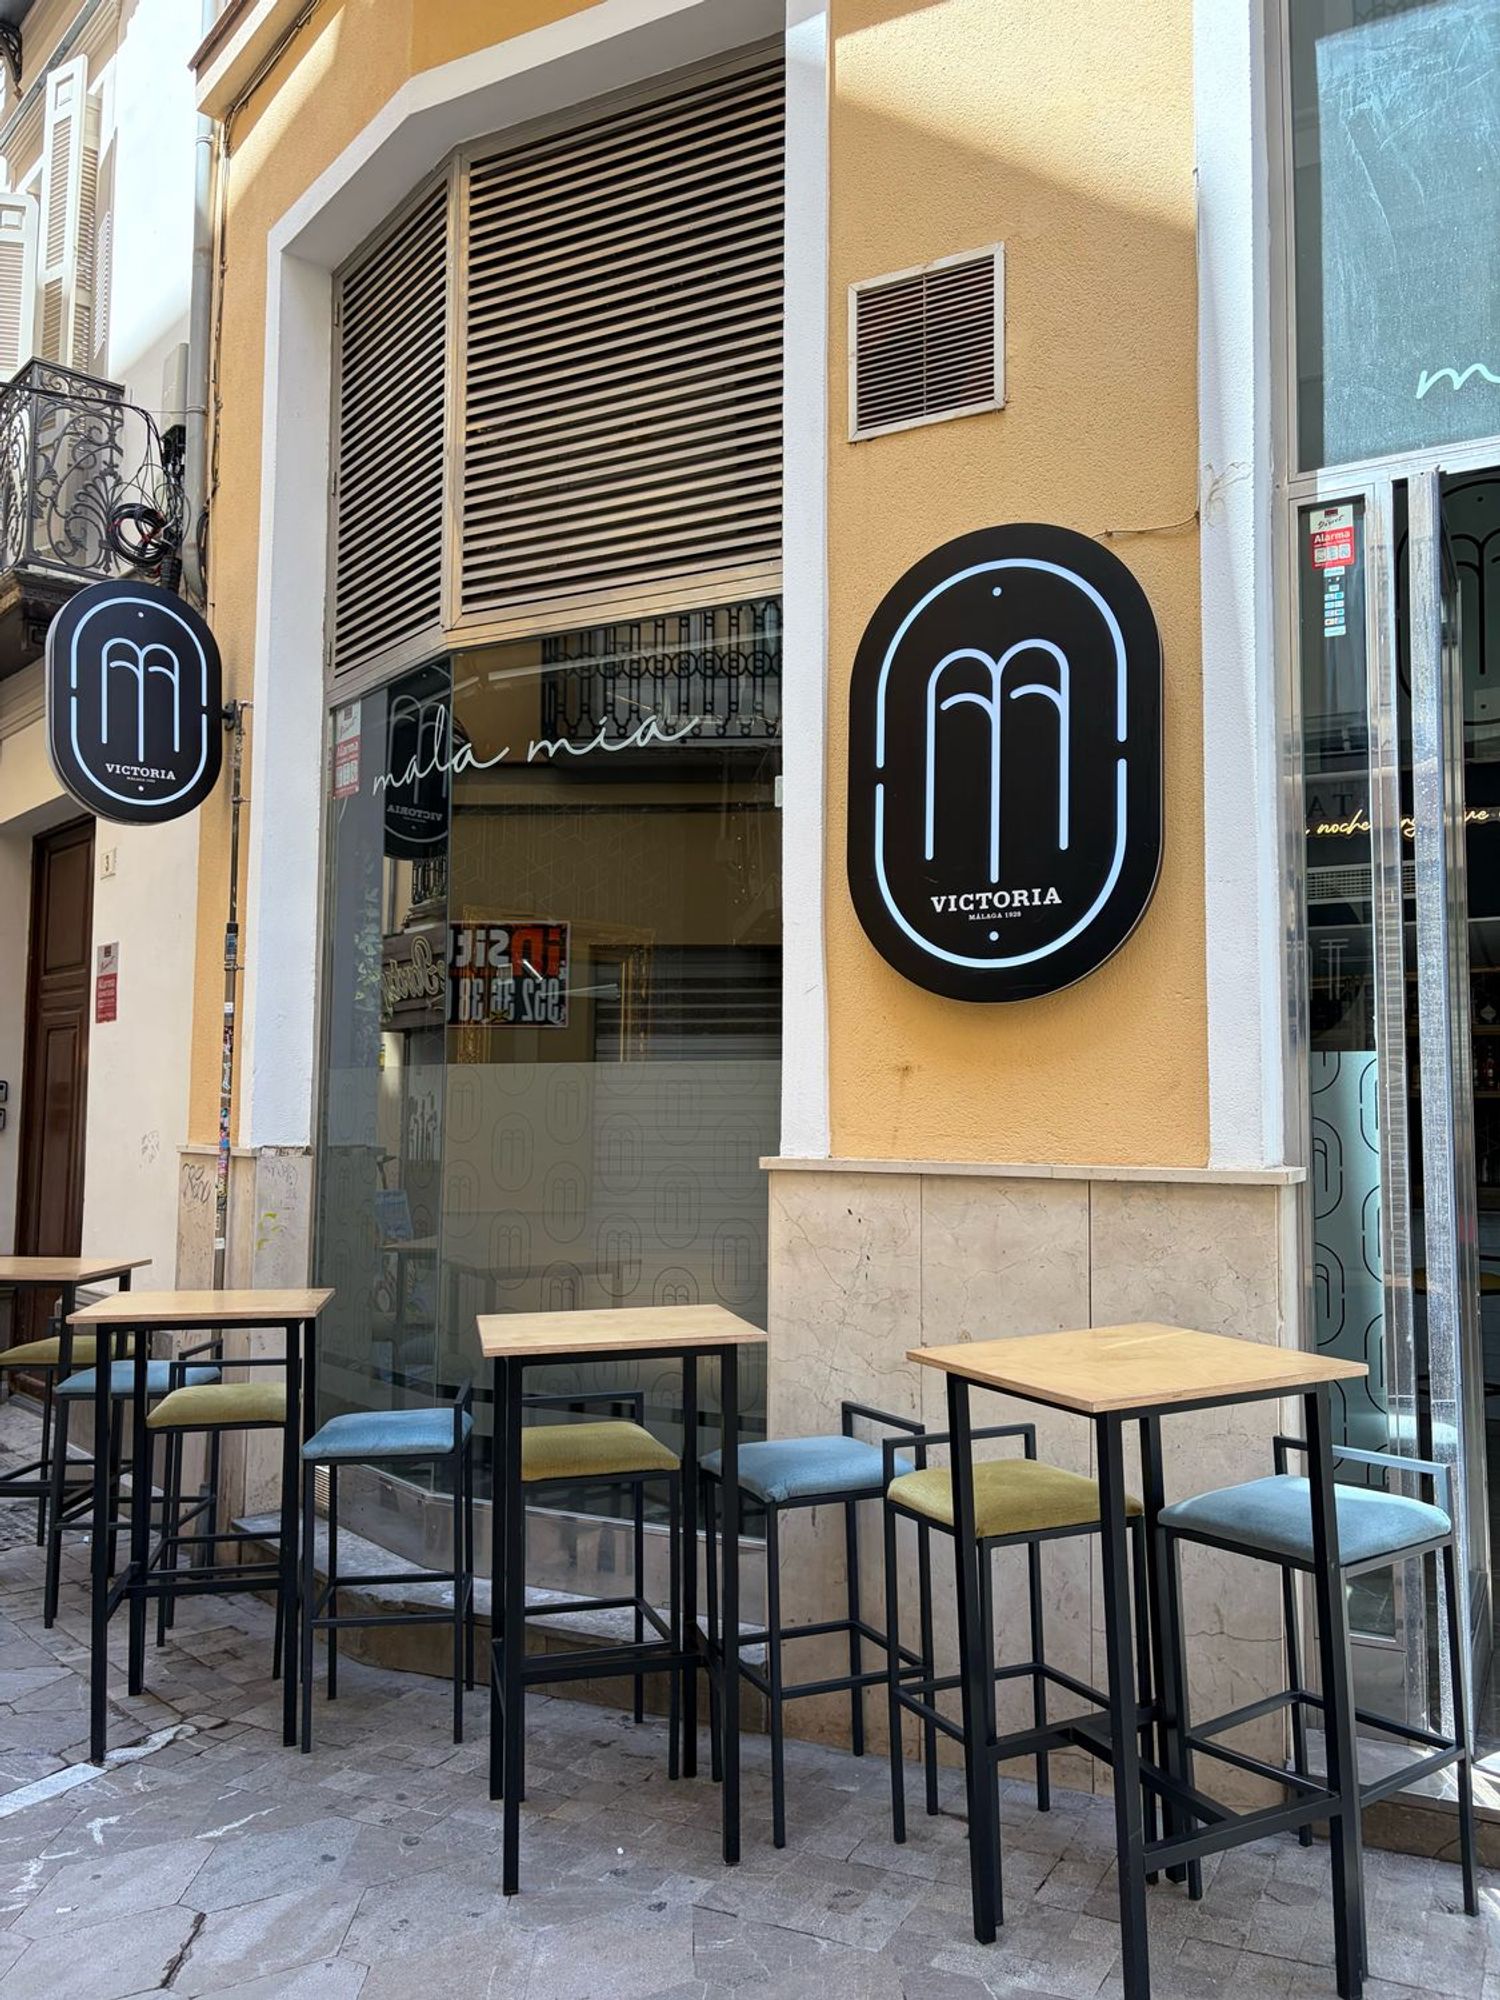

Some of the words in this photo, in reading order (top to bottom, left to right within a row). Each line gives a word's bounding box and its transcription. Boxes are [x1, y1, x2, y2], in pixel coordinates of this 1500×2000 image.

[1314, 531, 1351, 544] Alarma
[372, 704, 509, 796] mala
[105, 763, 176, 780] VICTORIA
[930, 887, 1062, 913] VICTORIA
